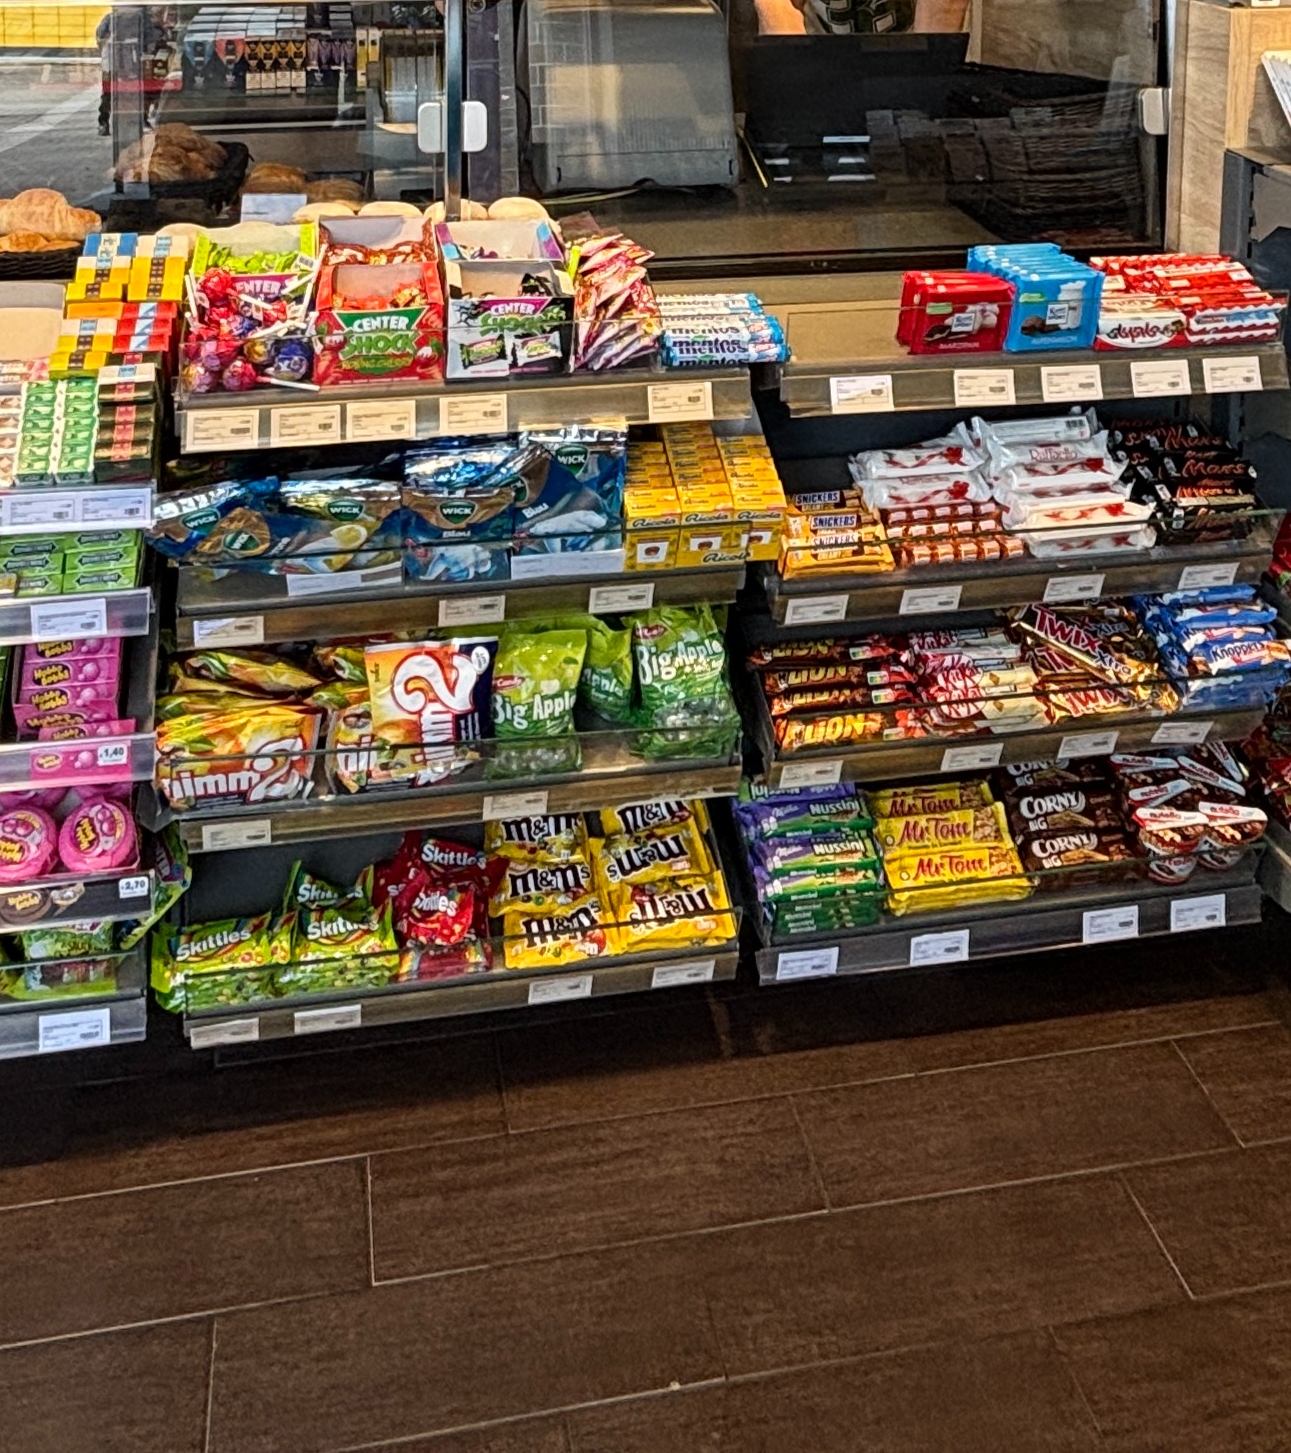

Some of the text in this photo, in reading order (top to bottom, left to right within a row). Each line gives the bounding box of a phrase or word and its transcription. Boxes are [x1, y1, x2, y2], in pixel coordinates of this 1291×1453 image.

[490, 303, 536, 316] CENTER
[353, 316, 410, 331] CENTER
[1109, 320, 1160, 343] duplo
[345, 330, 417, 358] SHOCK
[557, 453, 587, 465] WICK
[796, 491, 840, 504] SNICKERS
[328, 504, 361, 516] WICK
[442, 506, 473, 517] WICK
[737, 509, 781, 521] Ricola
[187, 514, 218, 530] WICK
[632, 517, 676, 528] Ricola
[684, 512, 730, 524] Ricola
[812, 514, 856, 528] SNICKERS
[442, 530, 472, 540] Blau
[813, 534, 856, 546] SNICKERS
[702, 550, 748, 564] Ricola
[1211, 640, 1268, 665] Knoppers
[636, 639, 724, 685] Big Apple
[1095, 651, 1133, 677] Xtra
[493, 694, 528, 730] Big
[805, 713, 866, 743] LION
[809, 800, 859, 816] Nussini
[1019, 791, 1086, 819] CORNY
[1149, 811, 1182, 821] nutella
[813, 841, 865, 856] Nussini
[1031, 832, 1098, 859] CORNY
[421, 845, 487, 870] Skittles
[1043, 856, 1062, 868] BIG
[176, 928, 252, 962] Skittles
